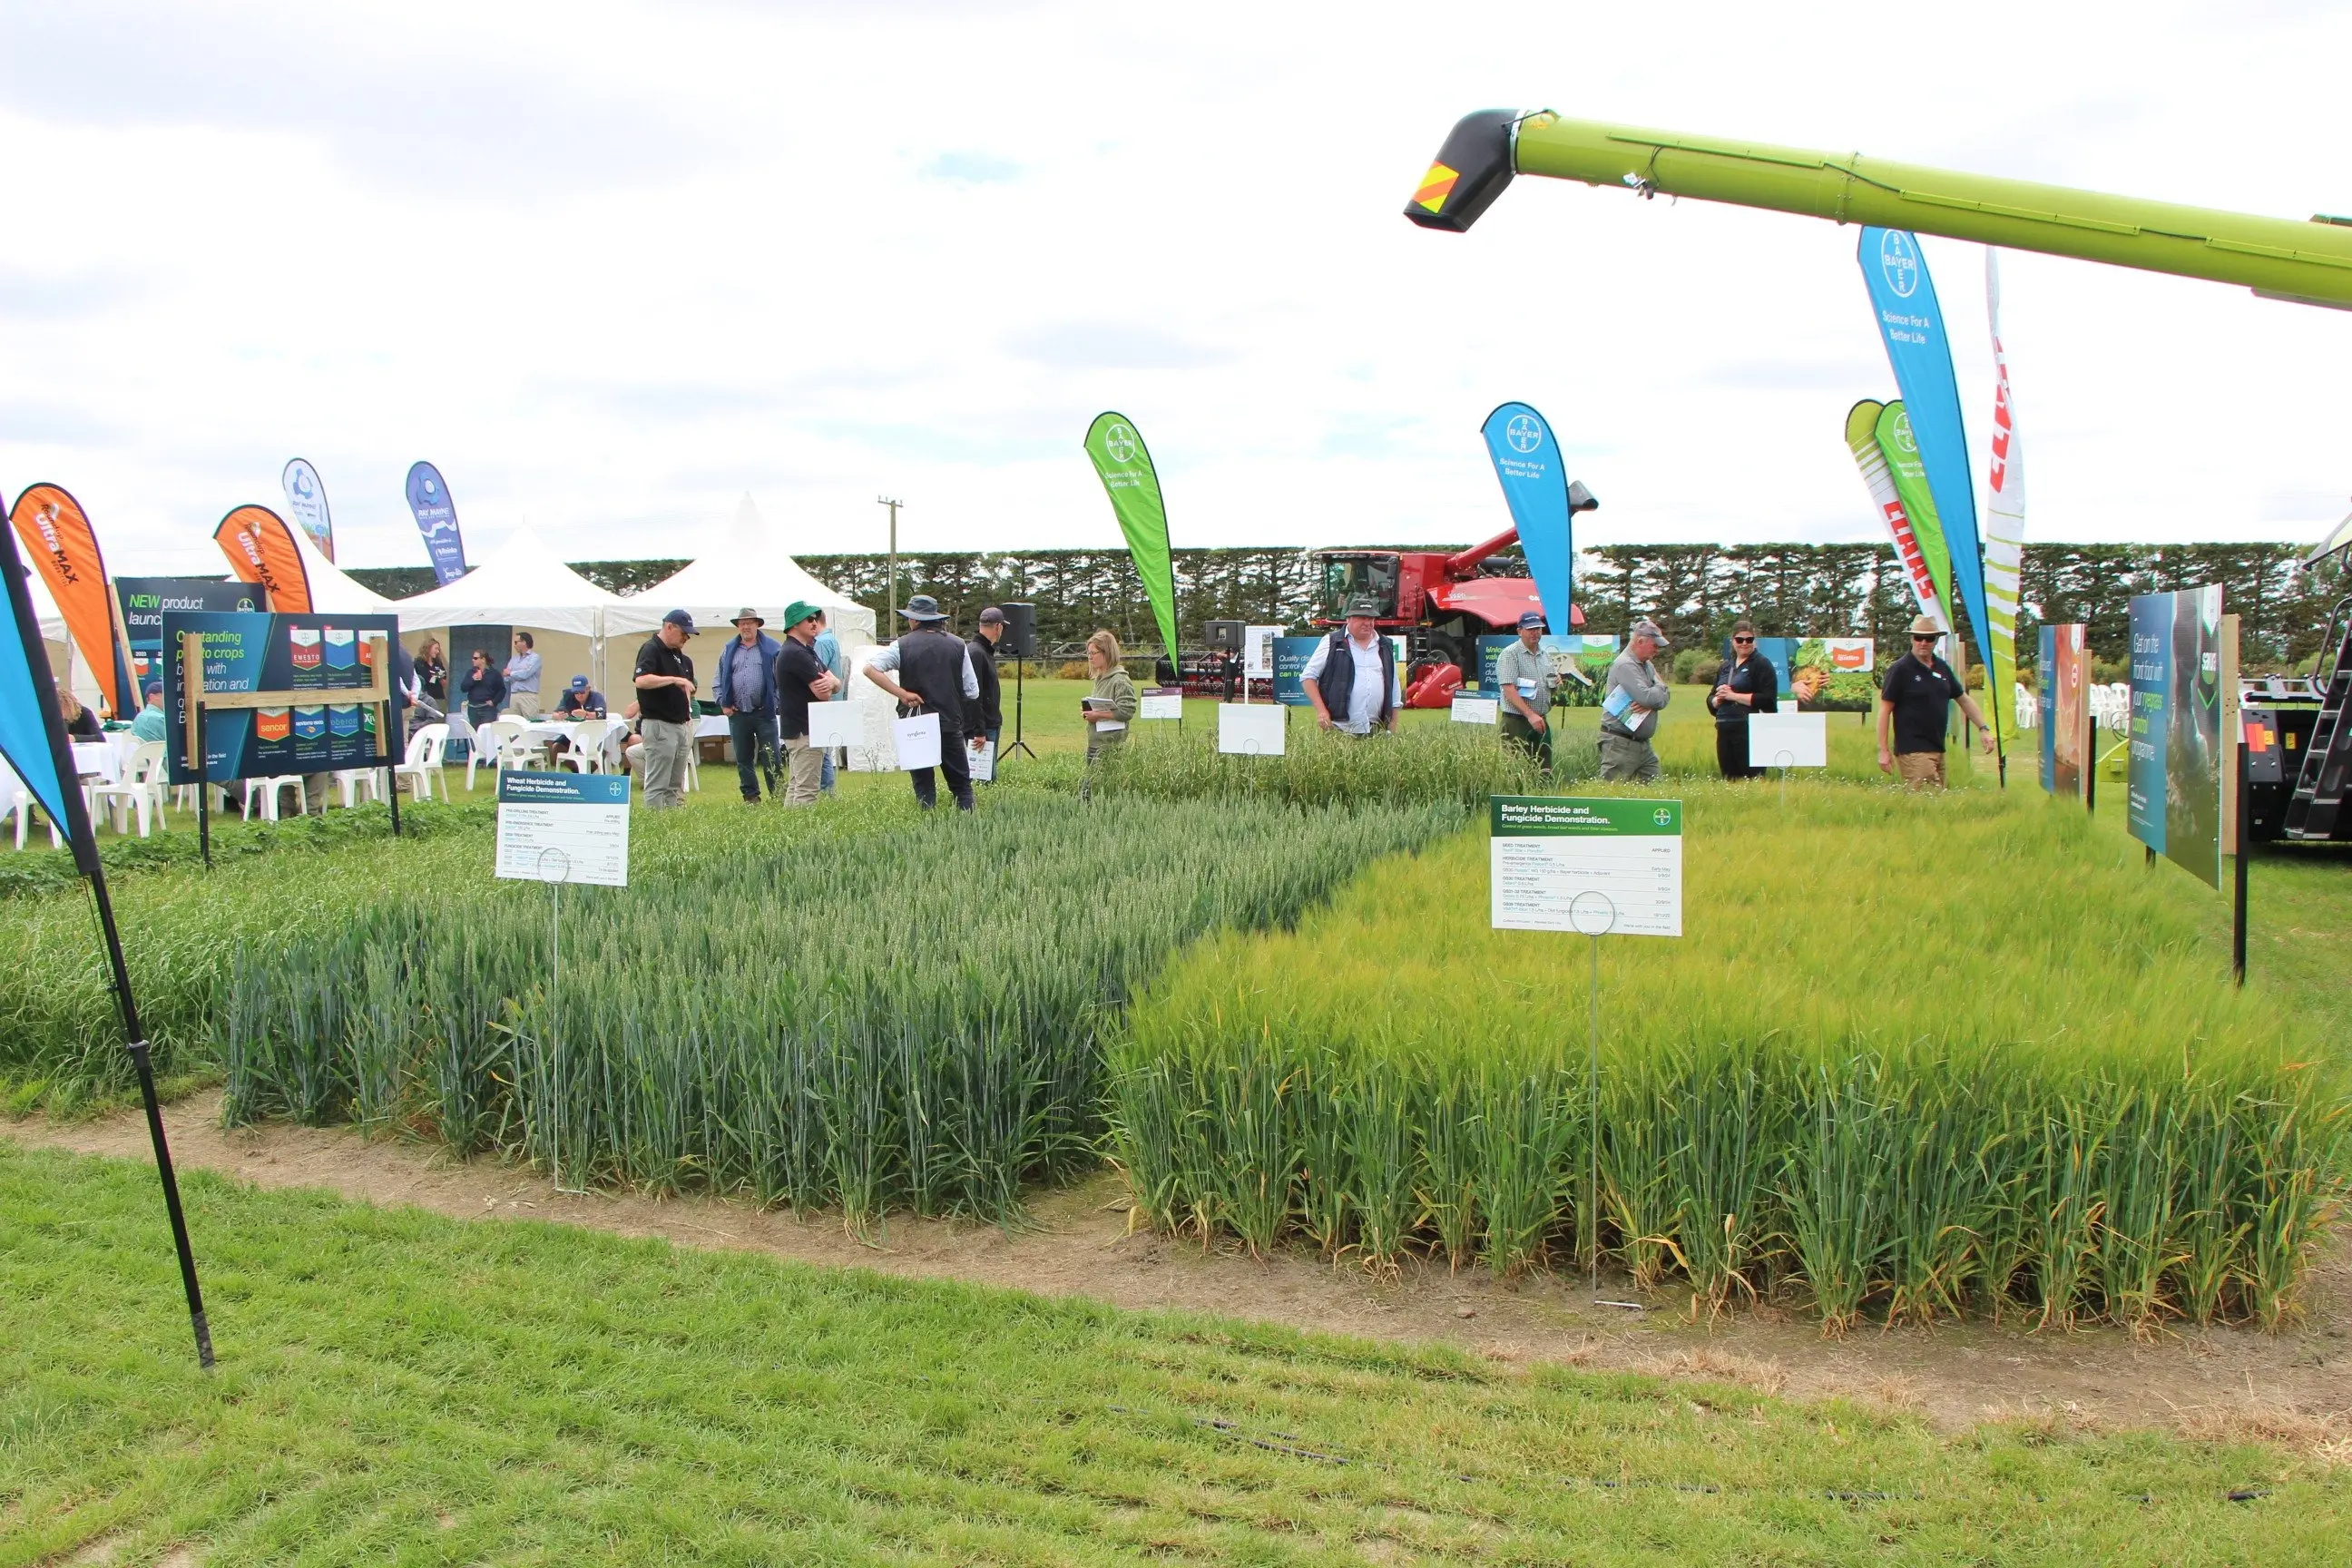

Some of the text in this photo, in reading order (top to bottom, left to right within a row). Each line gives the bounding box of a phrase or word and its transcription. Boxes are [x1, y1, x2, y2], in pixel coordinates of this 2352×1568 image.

[1884, 255, 1914, 270] BAYER
[1882, 310, 1929, 328] Science For A
[1889, 328, 1926, 344] Better Life
[1509, 429, 1539, 438] BAYER
[1499, 457, 1526, 468] Science
[1527, 462, 1539, 470] For
[1504, 467, 1540, 479] Better Life
[418, 507, 450, 516] RAY MAYNE
[1883, 500, 1938, 600] CLAAS
[129, 594, 204, 611] NEW product
[2133, 632, 2160, 654] Get on the
[213, 648, 245, 662] crops
[1279, 654, 1300, 663] Quality
[206, 663, 227, 675] with
[229, 678, 250, 691] and
[2132, 691, 2143, 710] your
[260, 723, 288, 732] sencor
[506, 777, 525, 785] Wheat
[506, 784, 581, 795] Fungicide Demonstration.
[1501, 805, 1589, 815] Barley Herbicide and
[1501, 814, 1611, 824] Fungicide Demonstration.
